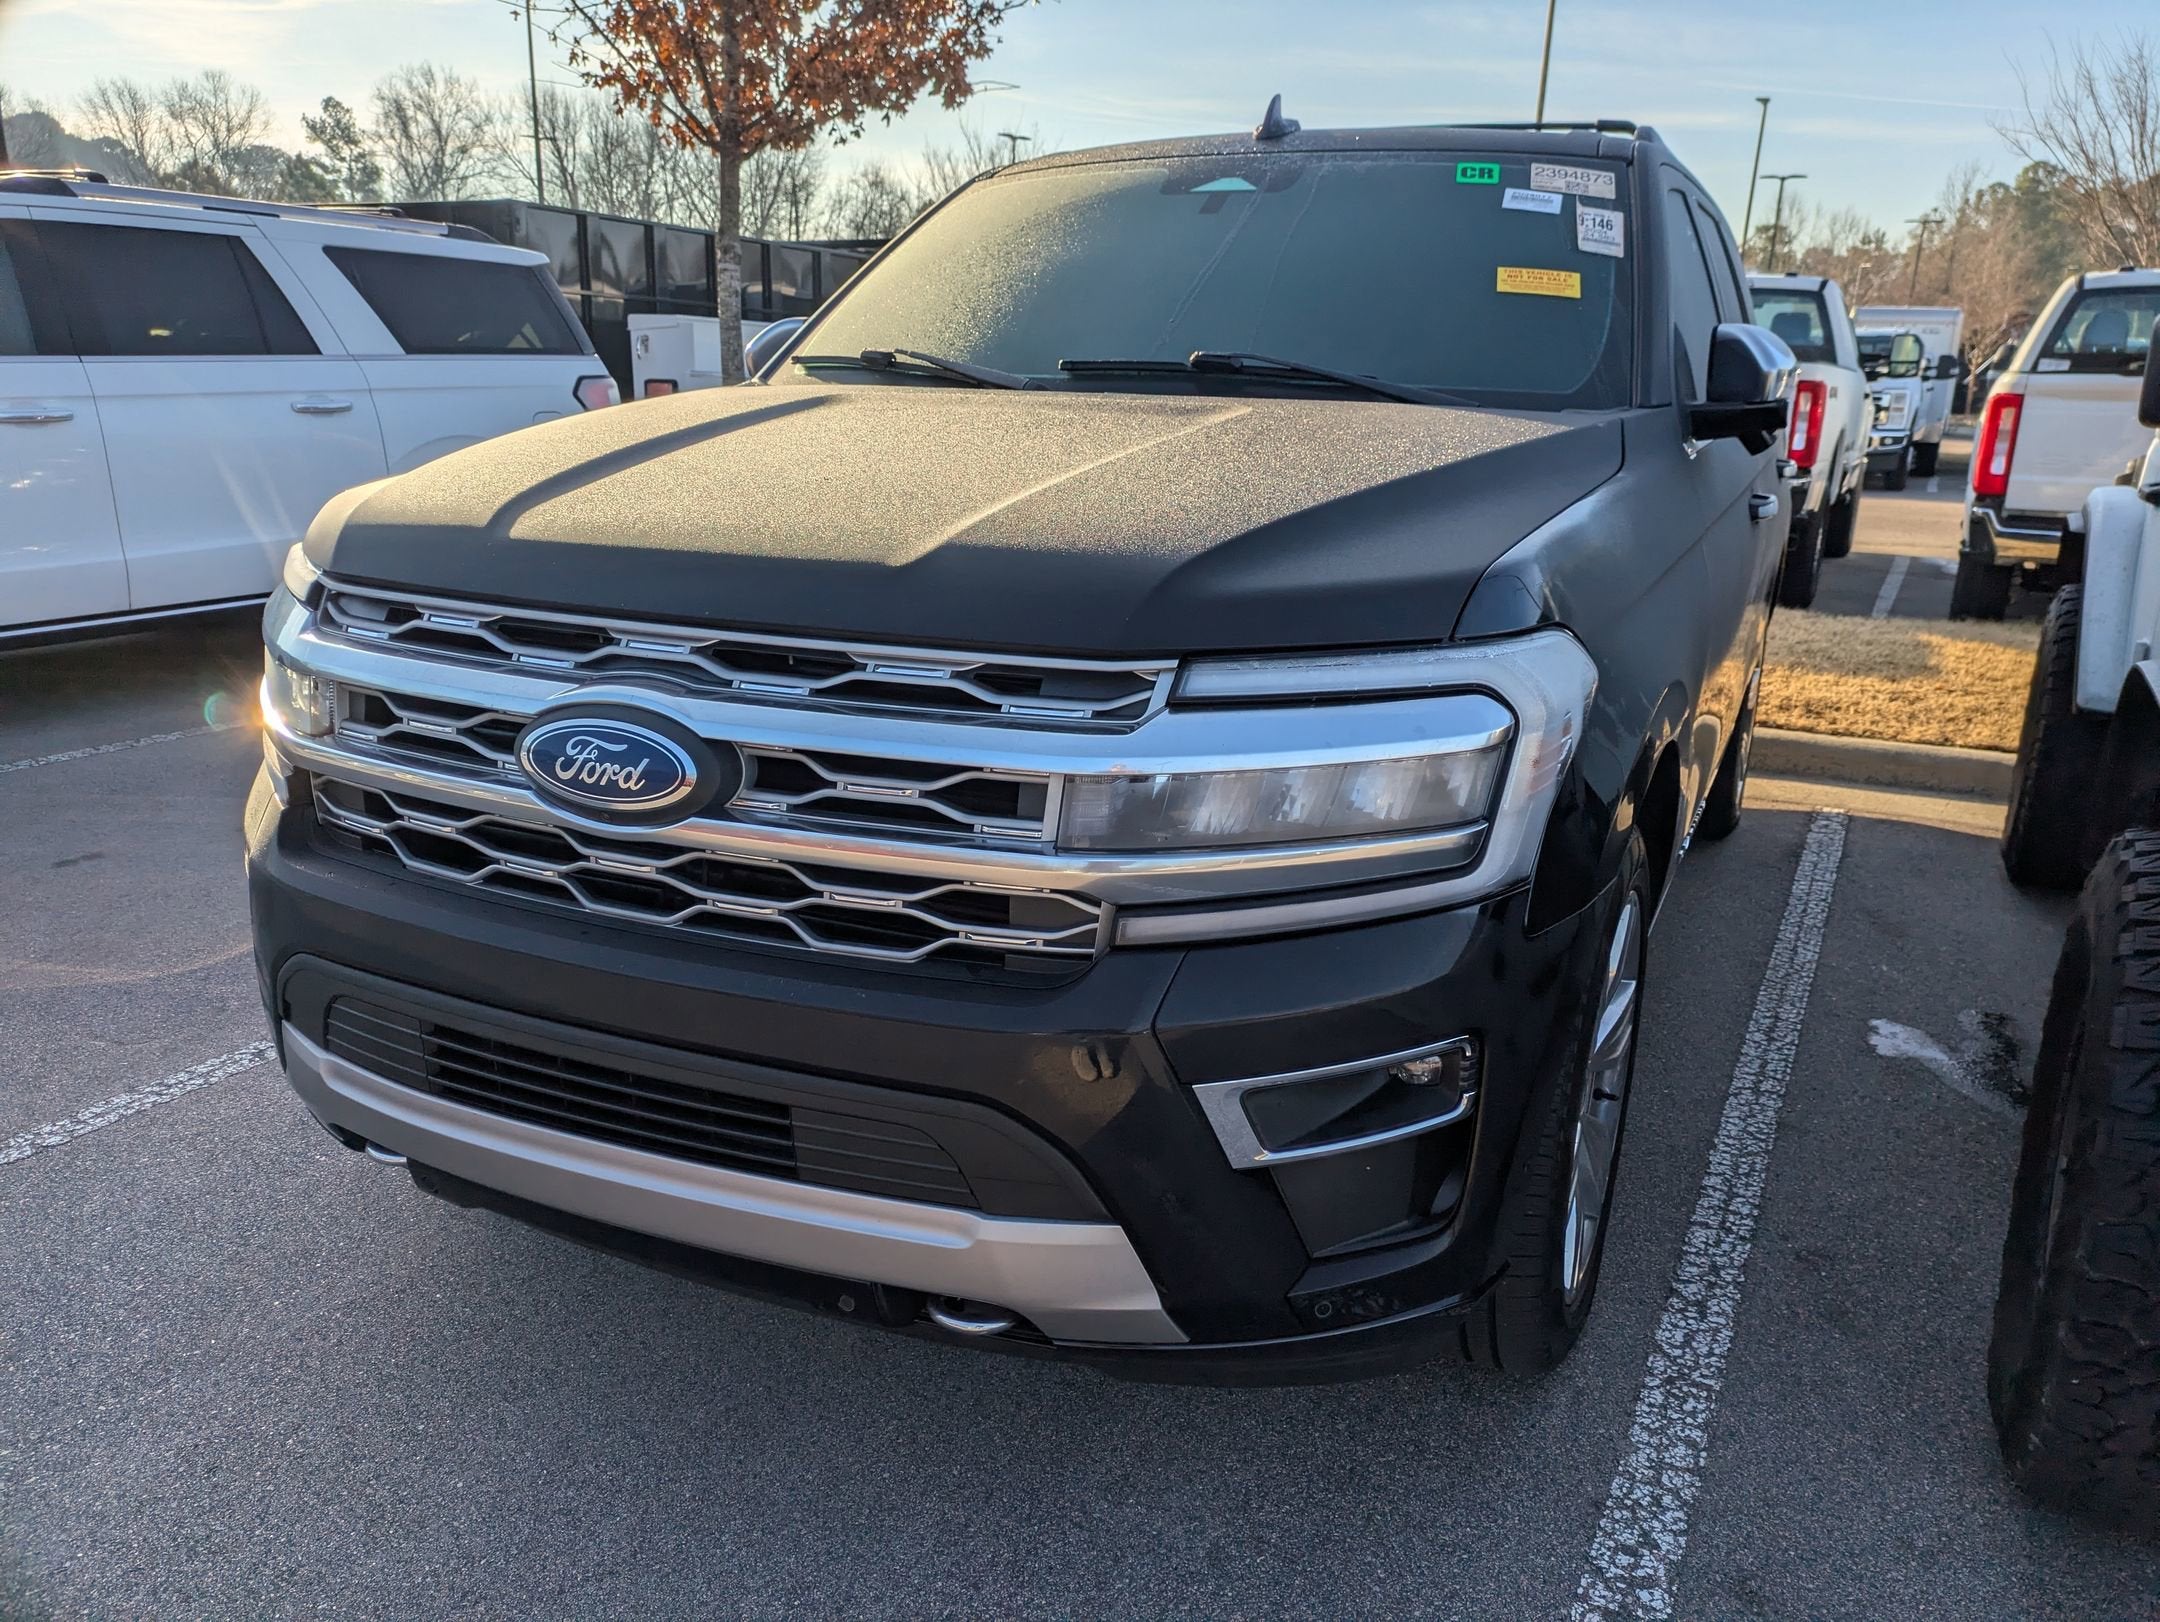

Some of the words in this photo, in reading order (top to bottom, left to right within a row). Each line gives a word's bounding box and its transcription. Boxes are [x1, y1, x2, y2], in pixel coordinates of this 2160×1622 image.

[1461, 166, 1494, 179] CR
[1534, 166, 1614, 185] 2394873
[555, 735, 650, 791] Ford
